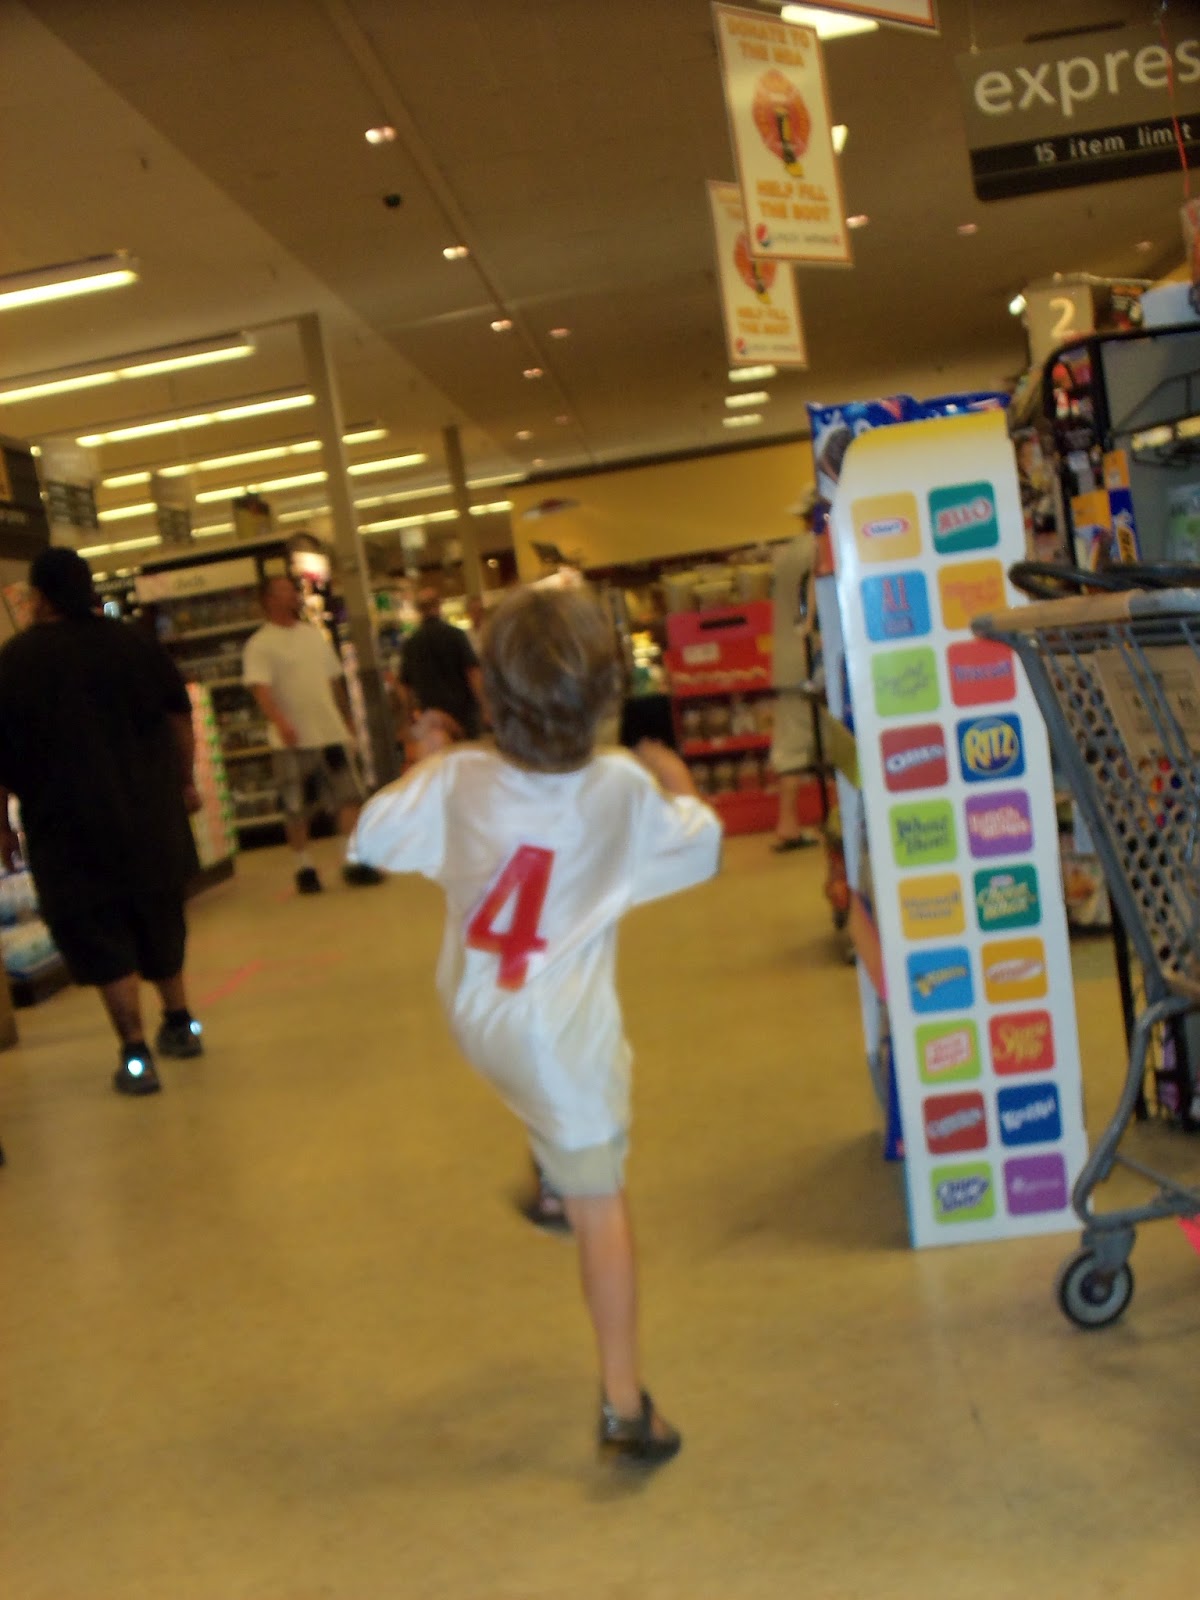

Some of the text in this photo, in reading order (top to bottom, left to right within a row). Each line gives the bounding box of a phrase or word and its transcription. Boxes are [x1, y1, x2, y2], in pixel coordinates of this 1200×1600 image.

[1034, 122, 1192, 165] 15 item limt
[1049, 297, 1076, 339] 2
[965, 724, 1016, 769] RITZ
[465, 844, 556, 993] 4
